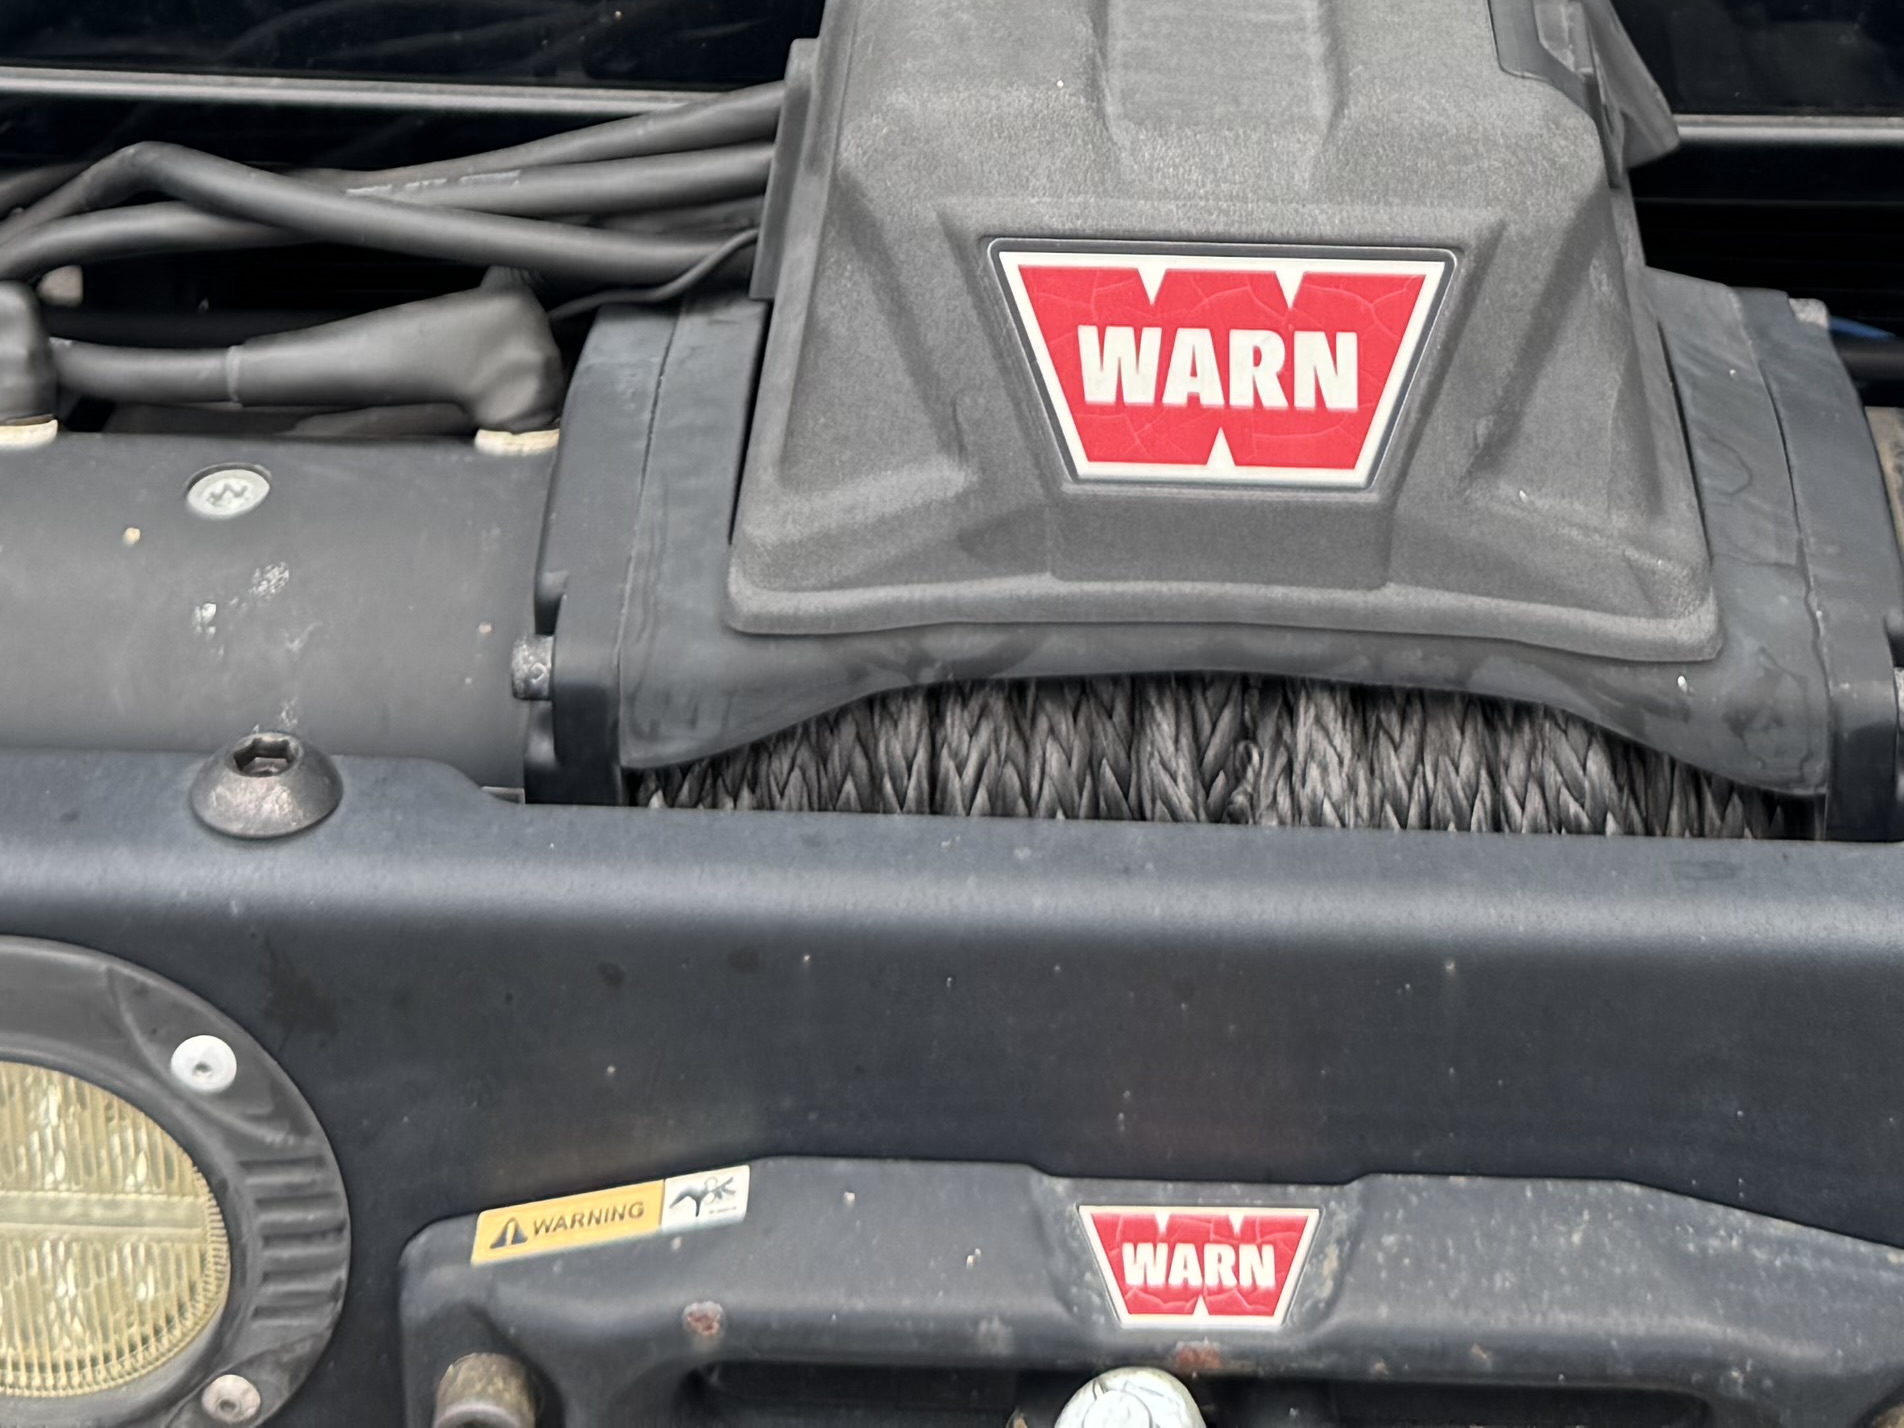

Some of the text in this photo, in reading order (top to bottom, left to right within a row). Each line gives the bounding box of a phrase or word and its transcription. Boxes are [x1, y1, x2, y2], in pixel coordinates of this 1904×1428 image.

[1077, 324, 1359, 411] WARN
[532, 1201, 645, 1236] WARNING
[1122, 1242, 1277, 1289] WARN
